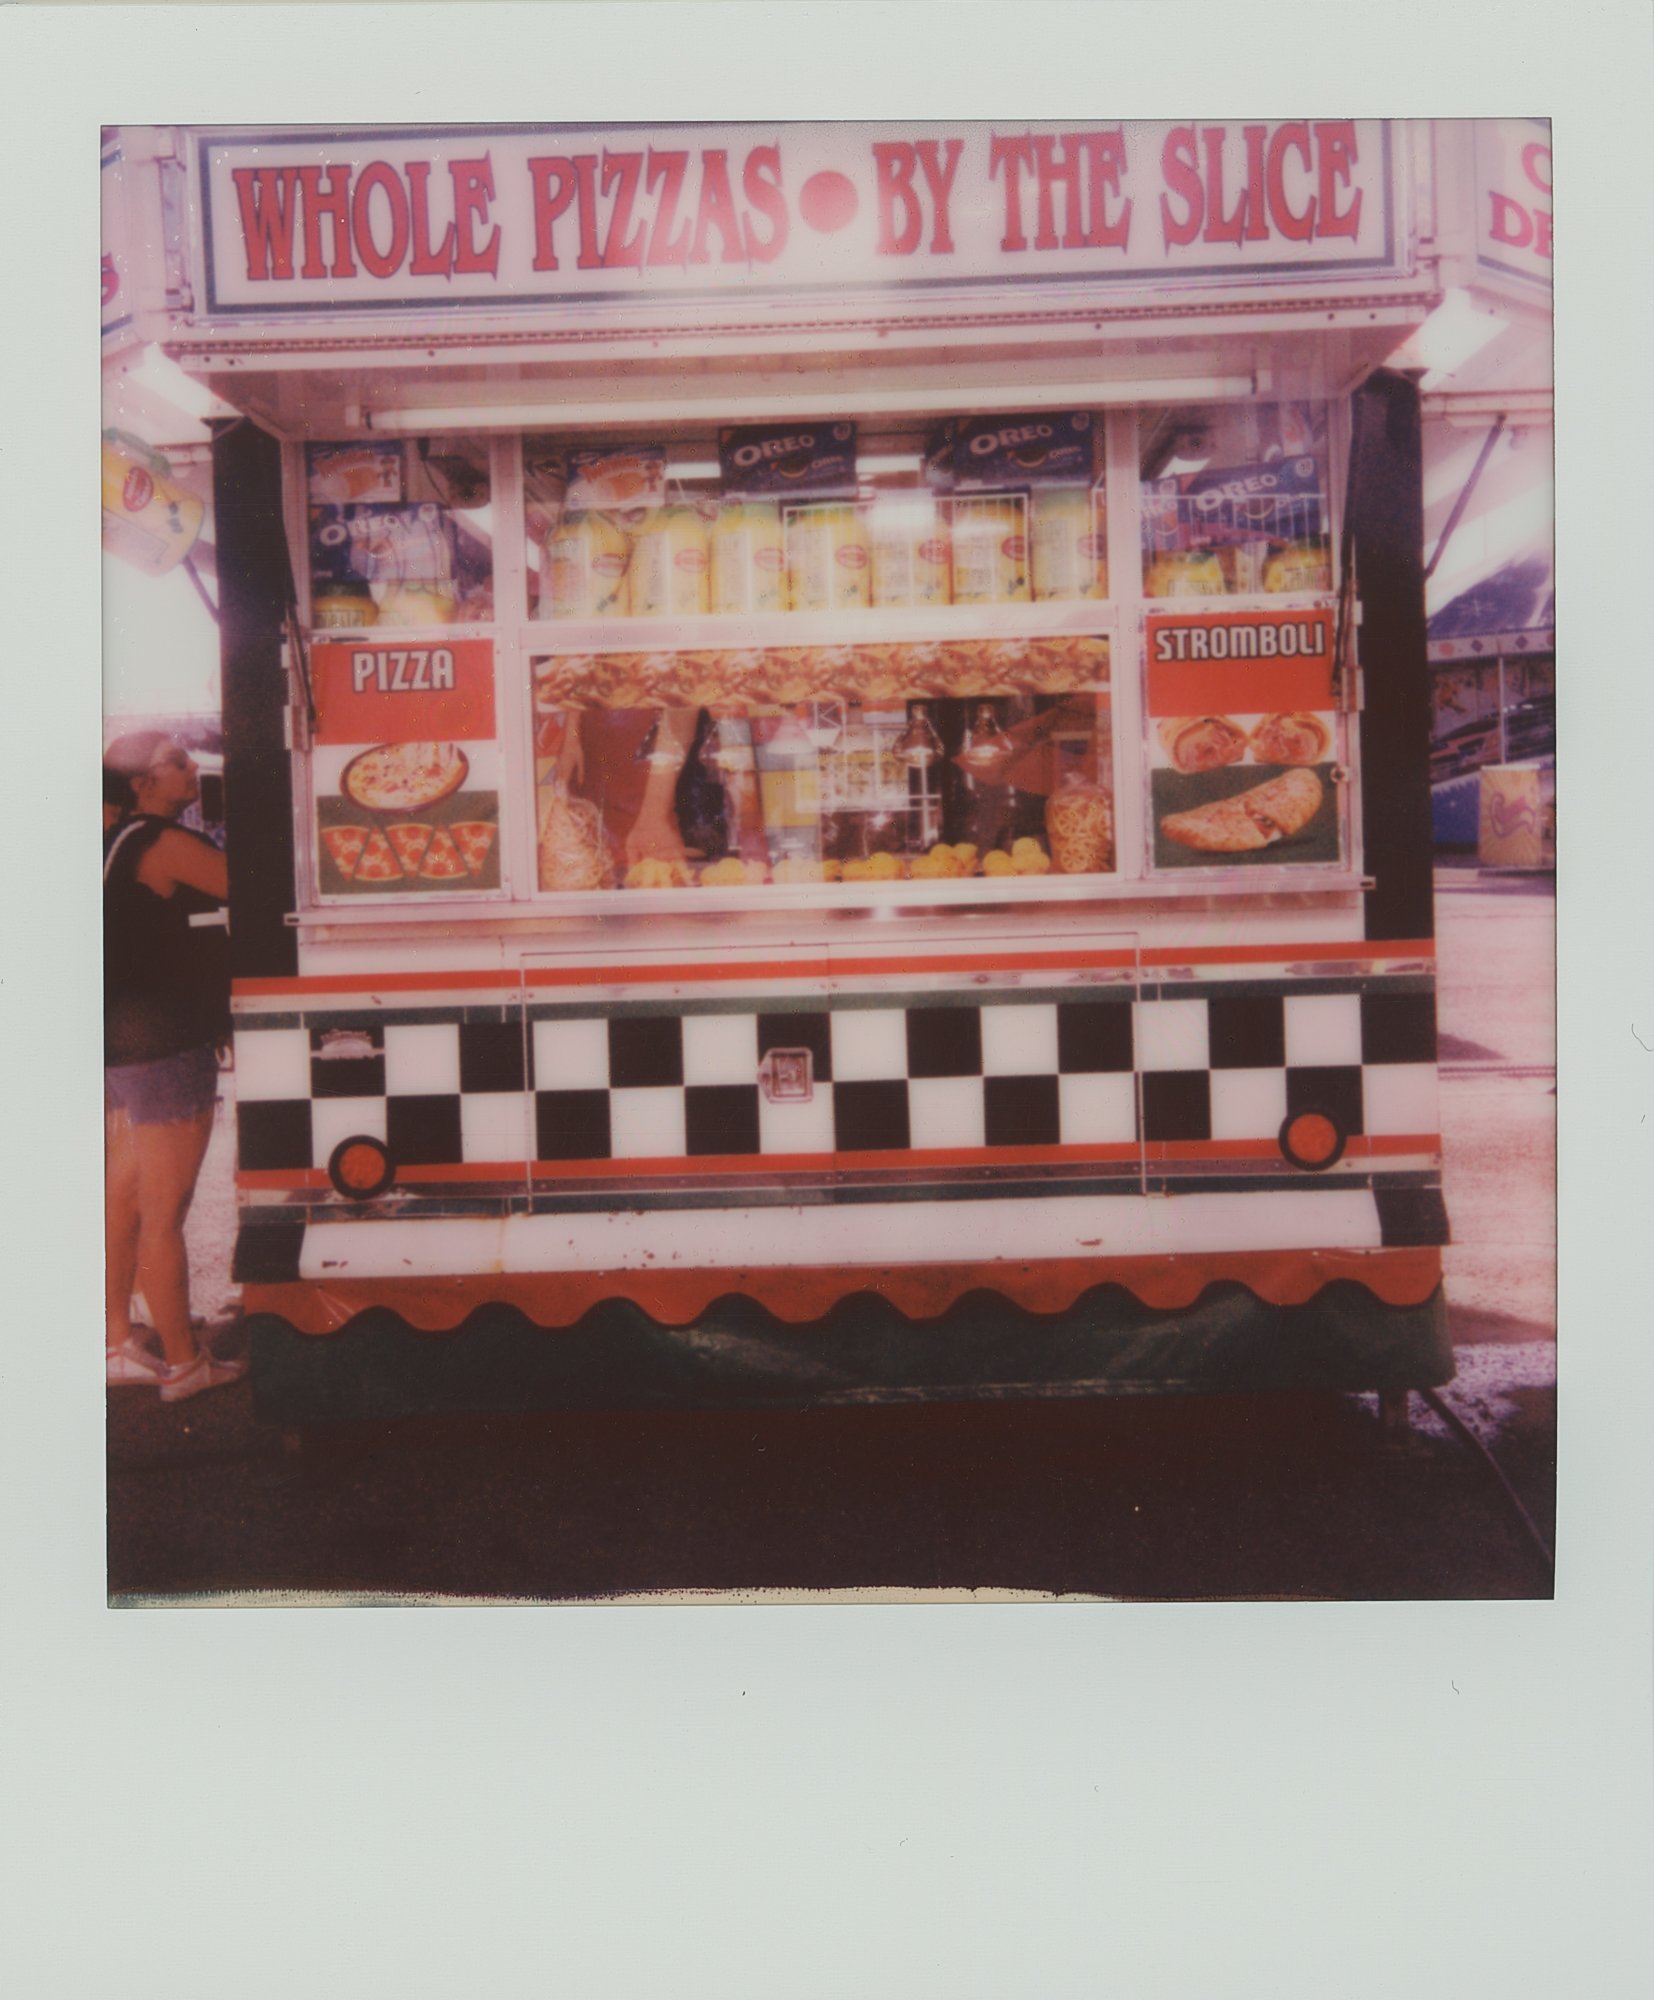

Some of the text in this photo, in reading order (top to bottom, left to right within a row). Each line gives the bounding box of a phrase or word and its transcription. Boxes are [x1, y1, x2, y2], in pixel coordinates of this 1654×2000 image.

[231, 149, 502, 282] WHOLE
[528, 138, 791, 276] PIZZAS
[872, 138, 965, 255] BY
[988, 130, 1133, 254] THE
[1160, 120, 1364, 252] SLICE
[733, 434, 816, 467] OREO
[969, 423, 1054, 456] OREO
[1195, 473, 1278, 512] OREO
[1155, 621, 1326, 662] STROMBOLI
[353, 648, 456, 694] PIZZA
